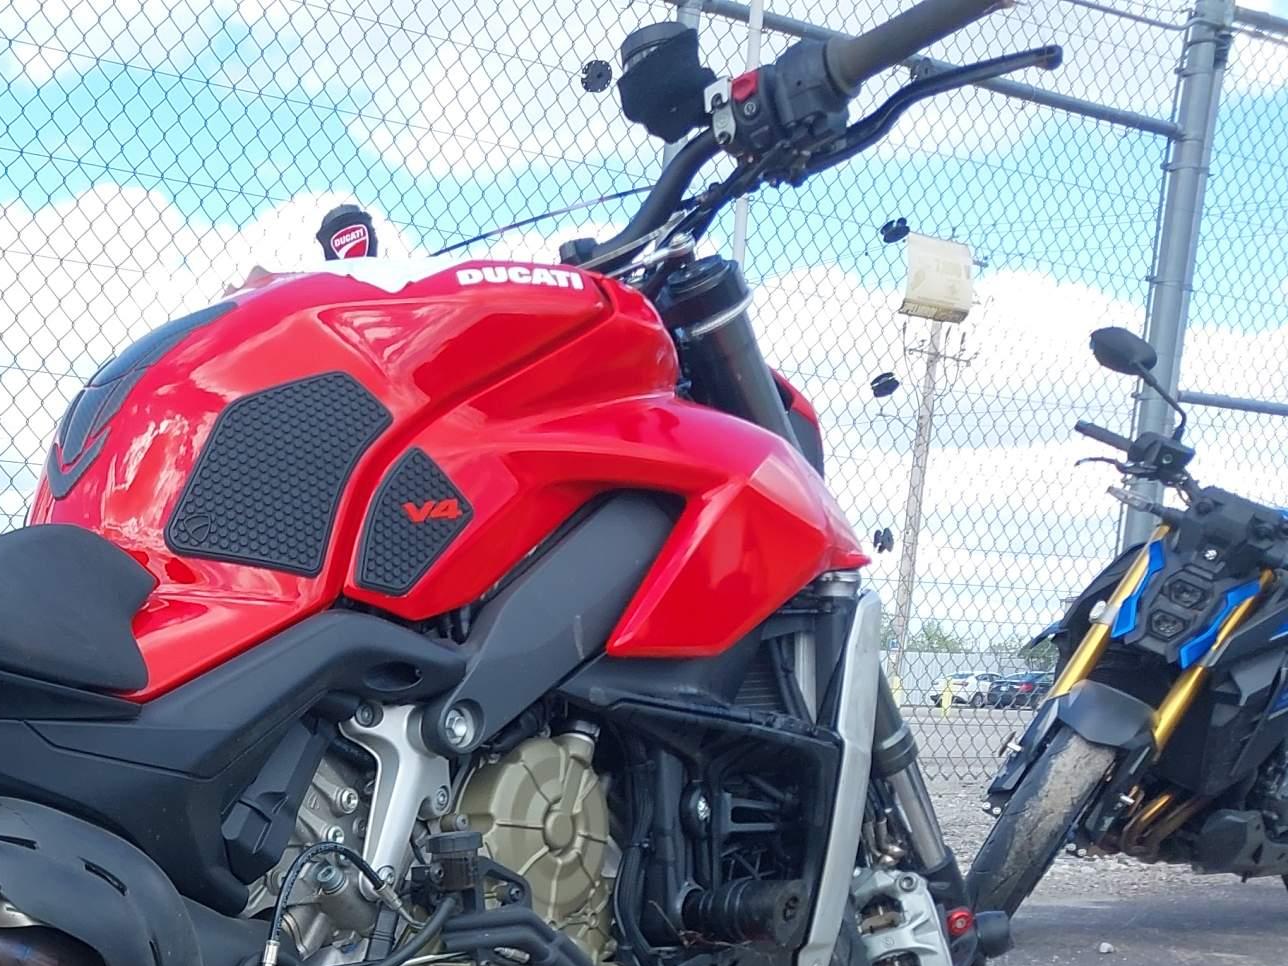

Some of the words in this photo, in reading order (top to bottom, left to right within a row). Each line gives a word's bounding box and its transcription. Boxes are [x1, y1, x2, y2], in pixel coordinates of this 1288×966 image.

[334, 228, 364, 247] DUCATI
[455, 266, 584, 291] DUCATI
[402, 498, 463, 523] V4
